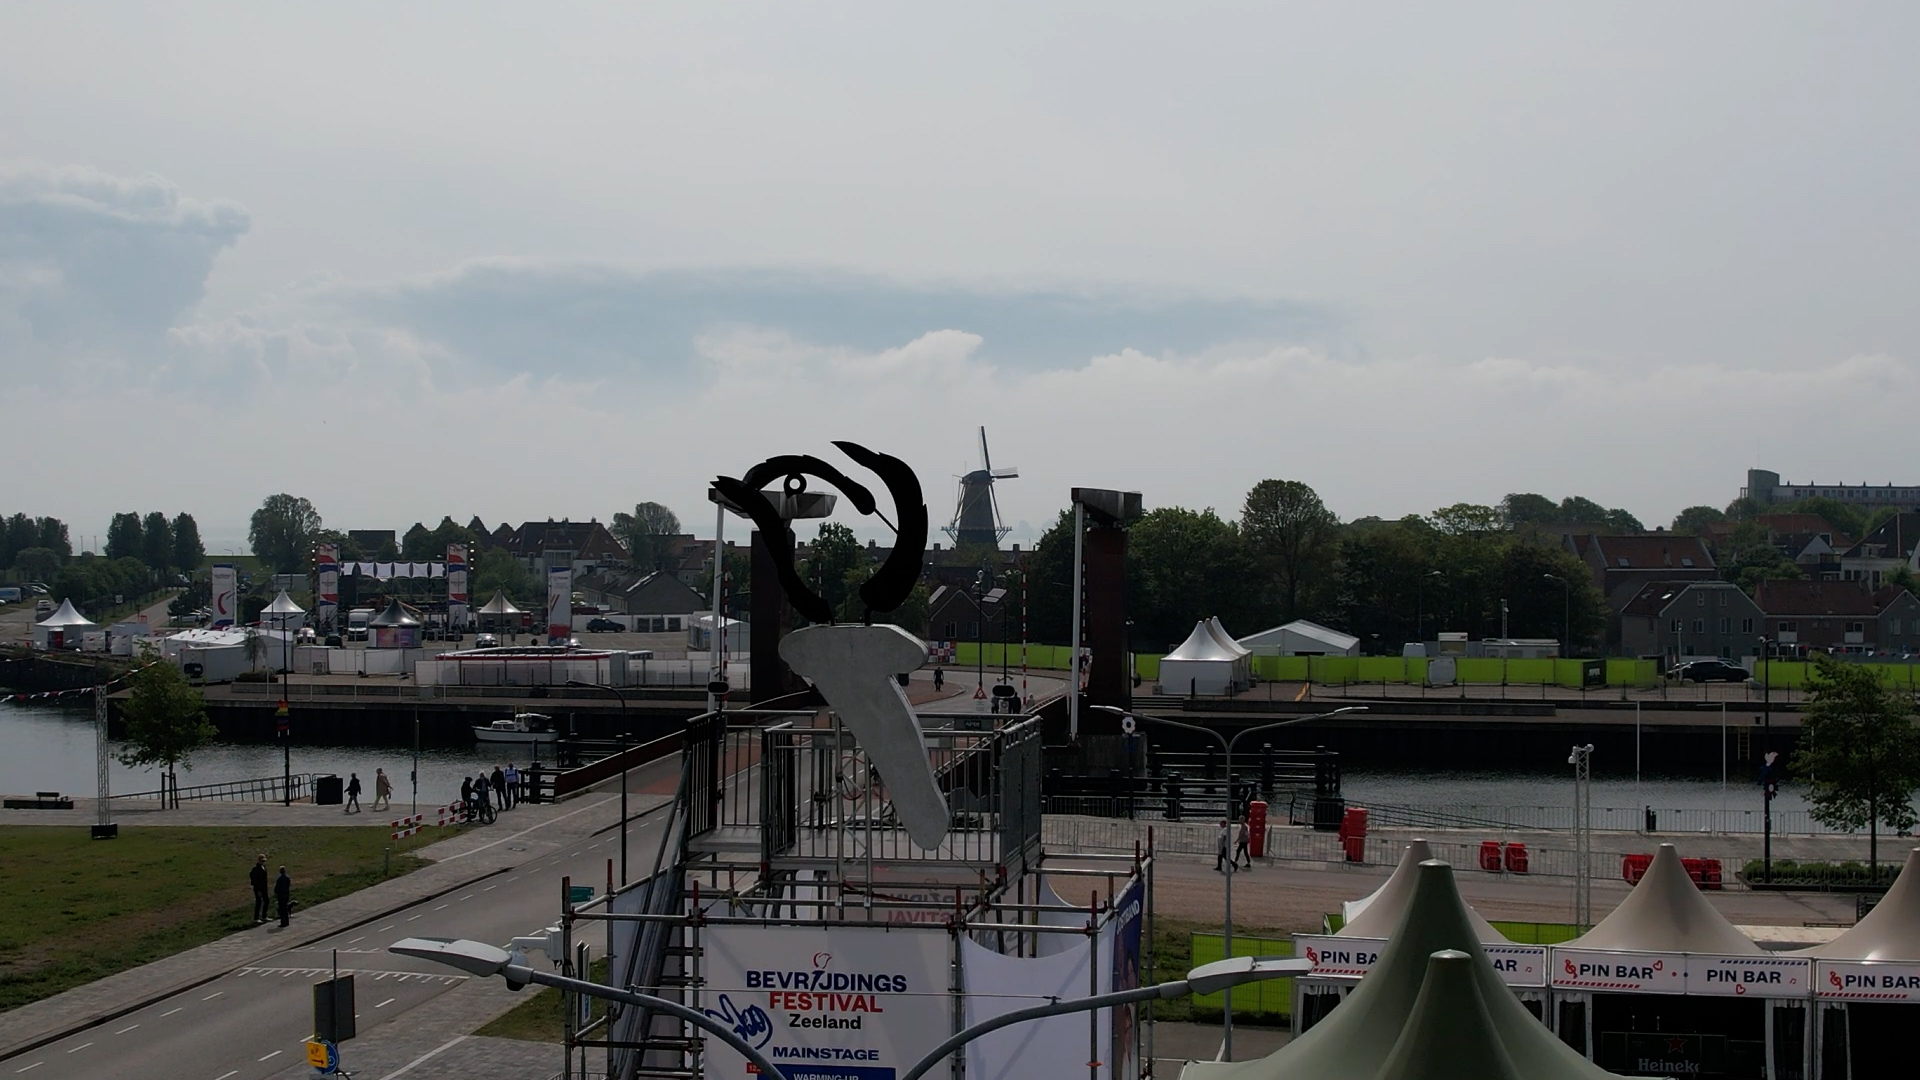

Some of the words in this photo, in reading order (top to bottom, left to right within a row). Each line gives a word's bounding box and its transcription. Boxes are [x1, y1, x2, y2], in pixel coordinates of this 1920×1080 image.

[1321, 951, 1350, 964] PIN
[1356, 953, 1378, 965] BA
[1494, 959, 1518, 972] AR
[1579, 964, 1610, 977] PIN
[1616, 966, 1654, 979] BAR
[1706, 969, 1738, 983] PIN
[1743, 971, 1782, 984] BAR
[746, 970, 907, 992] BEVRIJDINGS
[1845, 974, 1877, 987] PIN
[1882, 975, 1920, 989] BAR
[769, 992, 884, 1013] FESTIVAL
[789, 1013, 862, 1030] Zeeland
[772, 1046, 880, 1061] MAINSTAGE
[1638, 1058, 1700, 1073] Heineke
